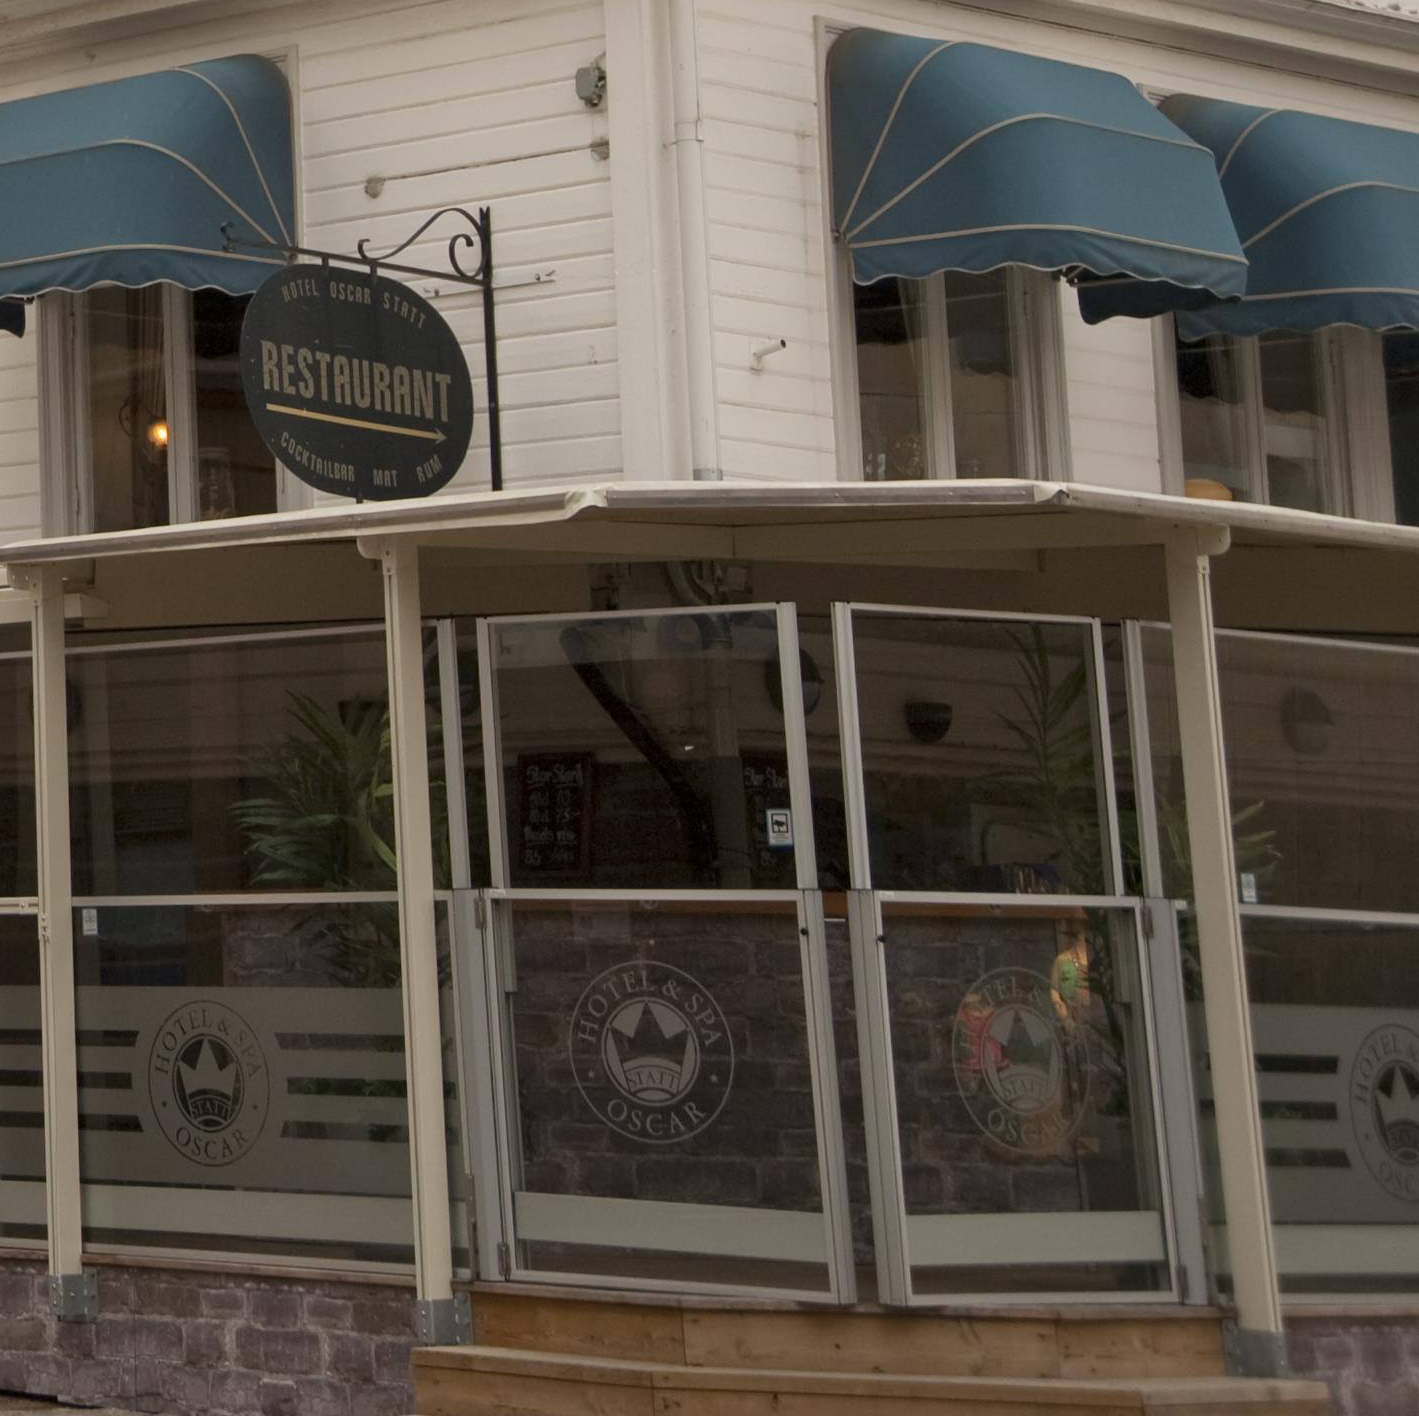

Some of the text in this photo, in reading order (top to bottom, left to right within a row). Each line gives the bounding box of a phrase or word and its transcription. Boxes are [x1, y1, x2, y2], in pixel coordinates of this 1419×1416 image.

[281, 278, 428, 329] HOTEL OSCAR STATT
[259, 339, 452, 423] RESTAURANT
[279, 430, 443, 489] COCKTAILBAR MAT RUM
[577, 969, 724, 1050] HOTEL & SPA
[153, 1008, 262, 1078] HOTEL & SPA
[1354, 1031, 1402, 1105] HOTEL
[627, 1070, 681, 1091] STATT
[191, 1098, 231, 1122] STATT
[606, 1098, 707, 1137] OSCAR
[175, 1126, 249, 1161] OSCAR
